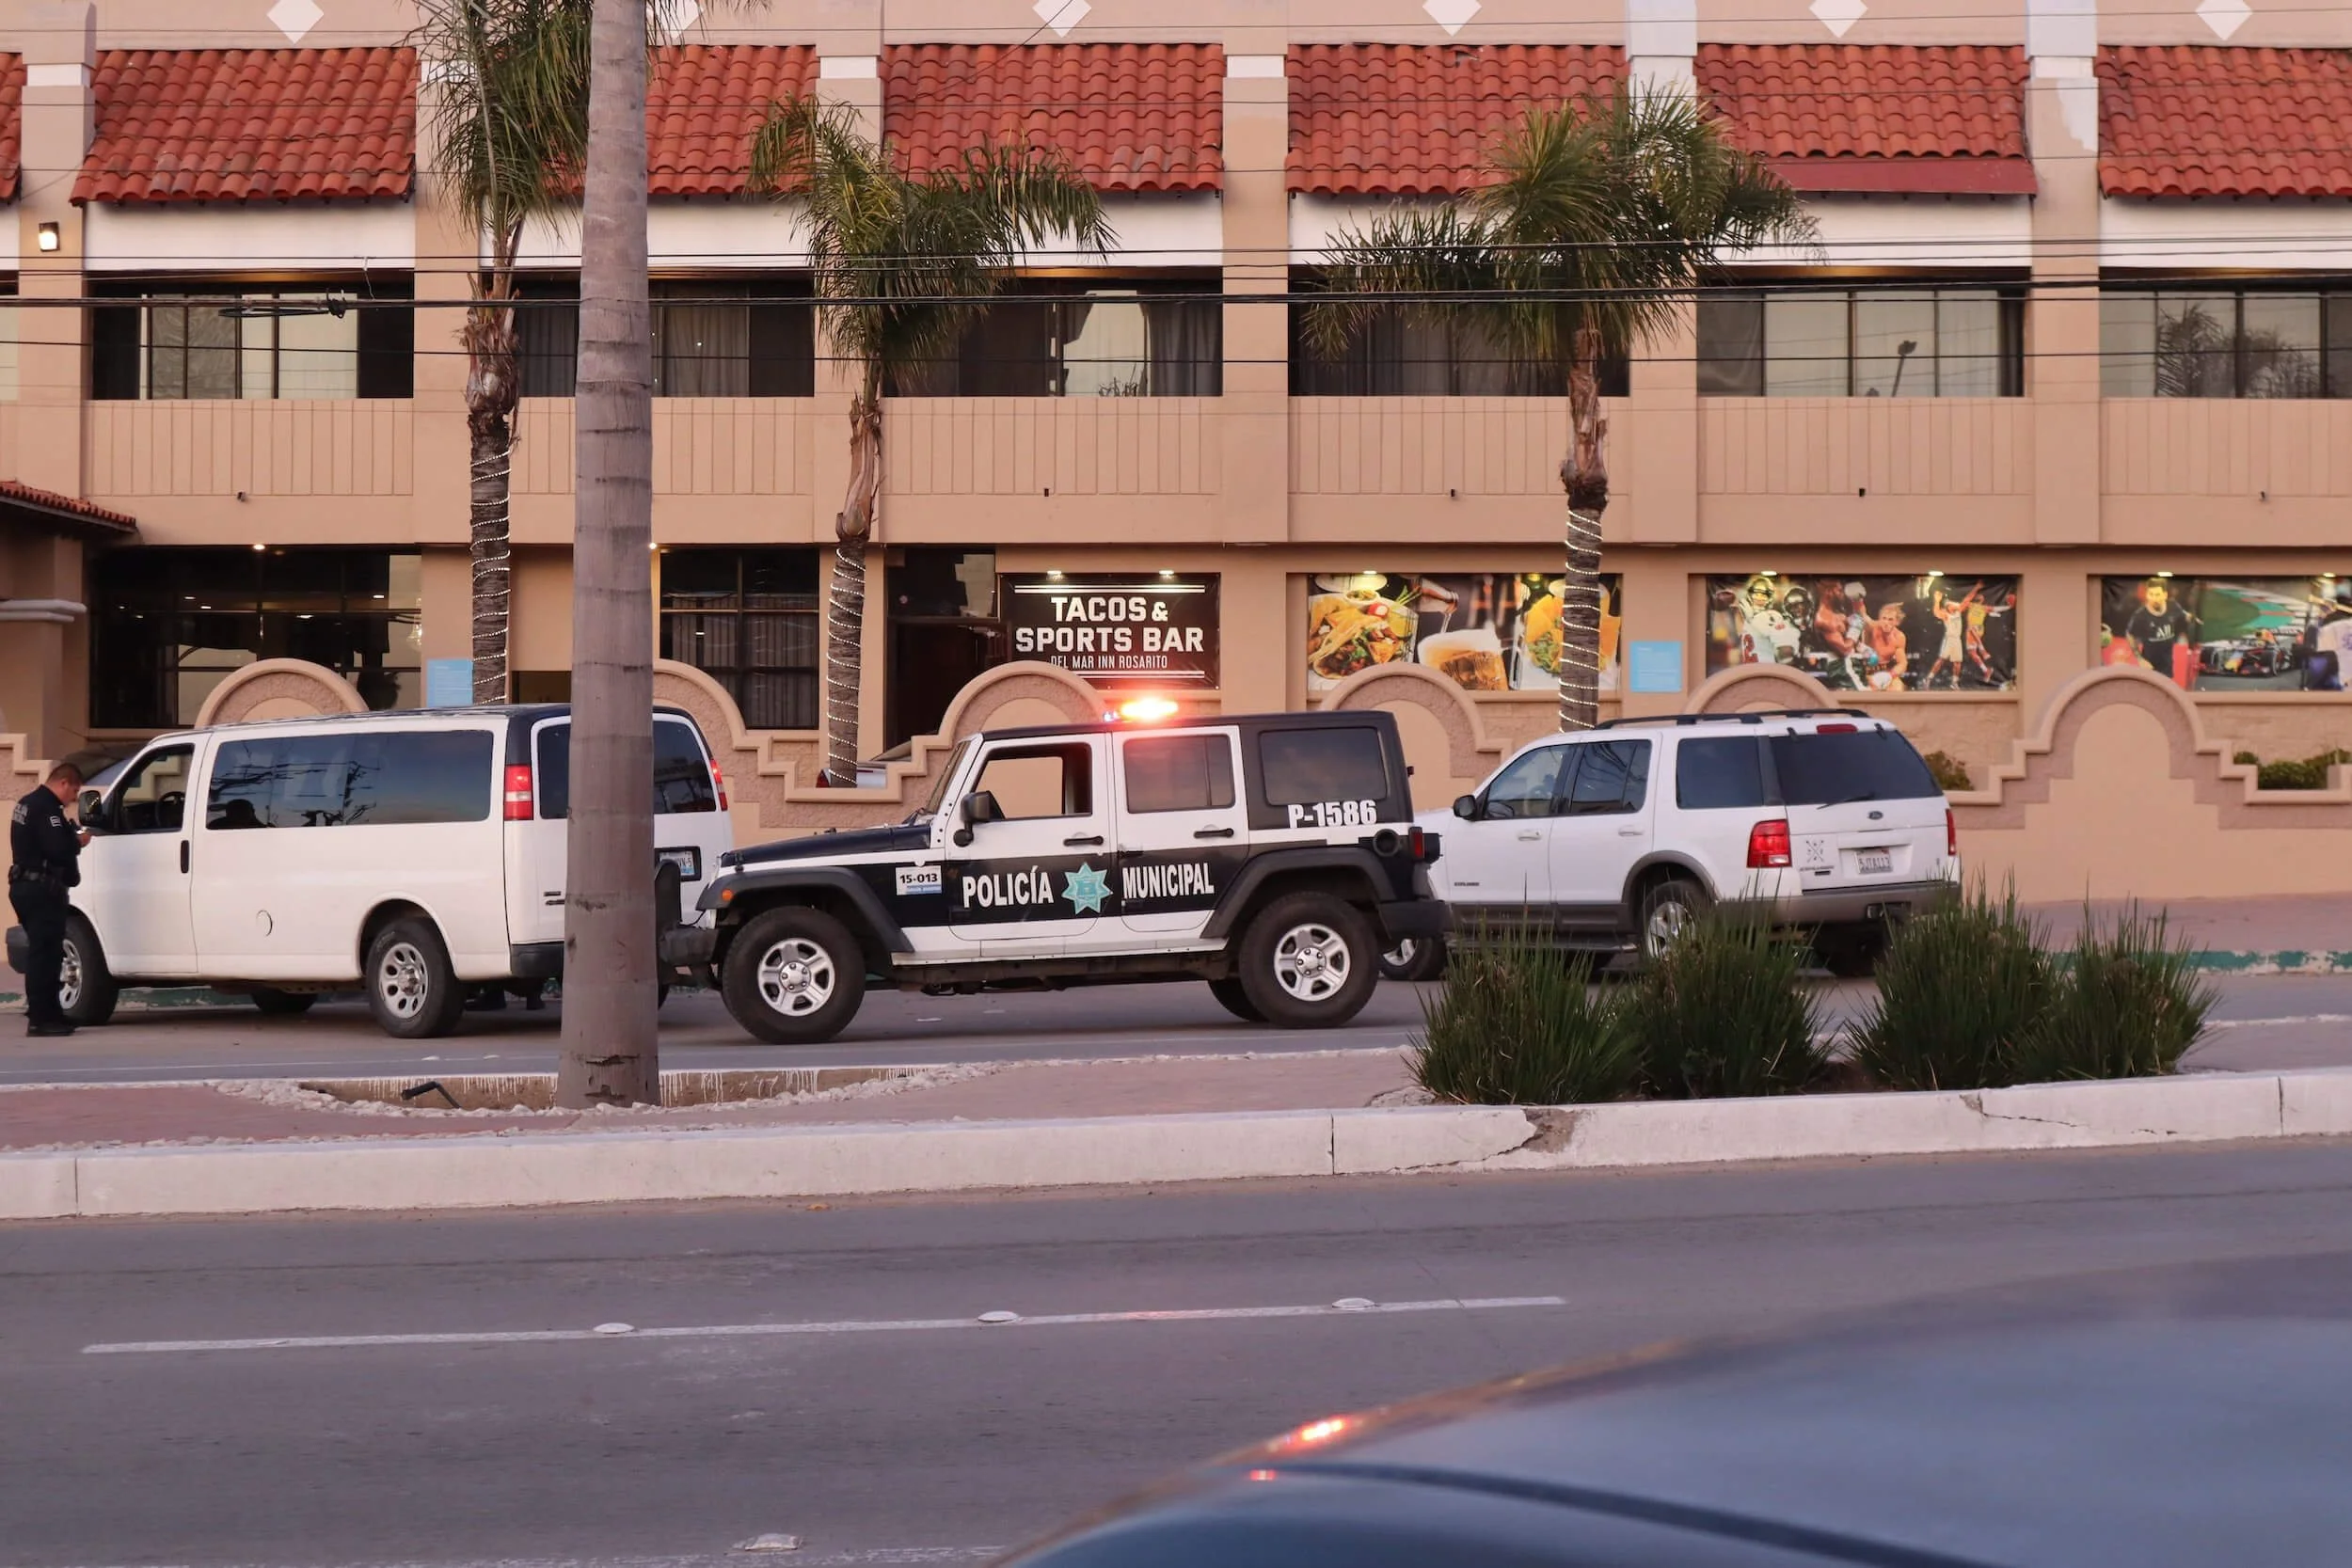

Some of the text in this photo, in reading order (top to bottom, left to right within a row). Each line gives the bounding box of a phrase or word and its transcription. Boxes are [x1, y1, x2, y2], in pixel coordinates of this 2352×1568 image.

[1051, 596, 1168, 622] TACOS &
[1015, 626, 1204, 653] SPORTS BAR
[1051, 655, 1168, 669] DEL MAR INN ROSARITO
[1287, 800, 1377, 829] P-1586
[899, 873, 938, 884] 15-013
[962, 863, 1215, 908] POLICÍA MUNICIPAL
